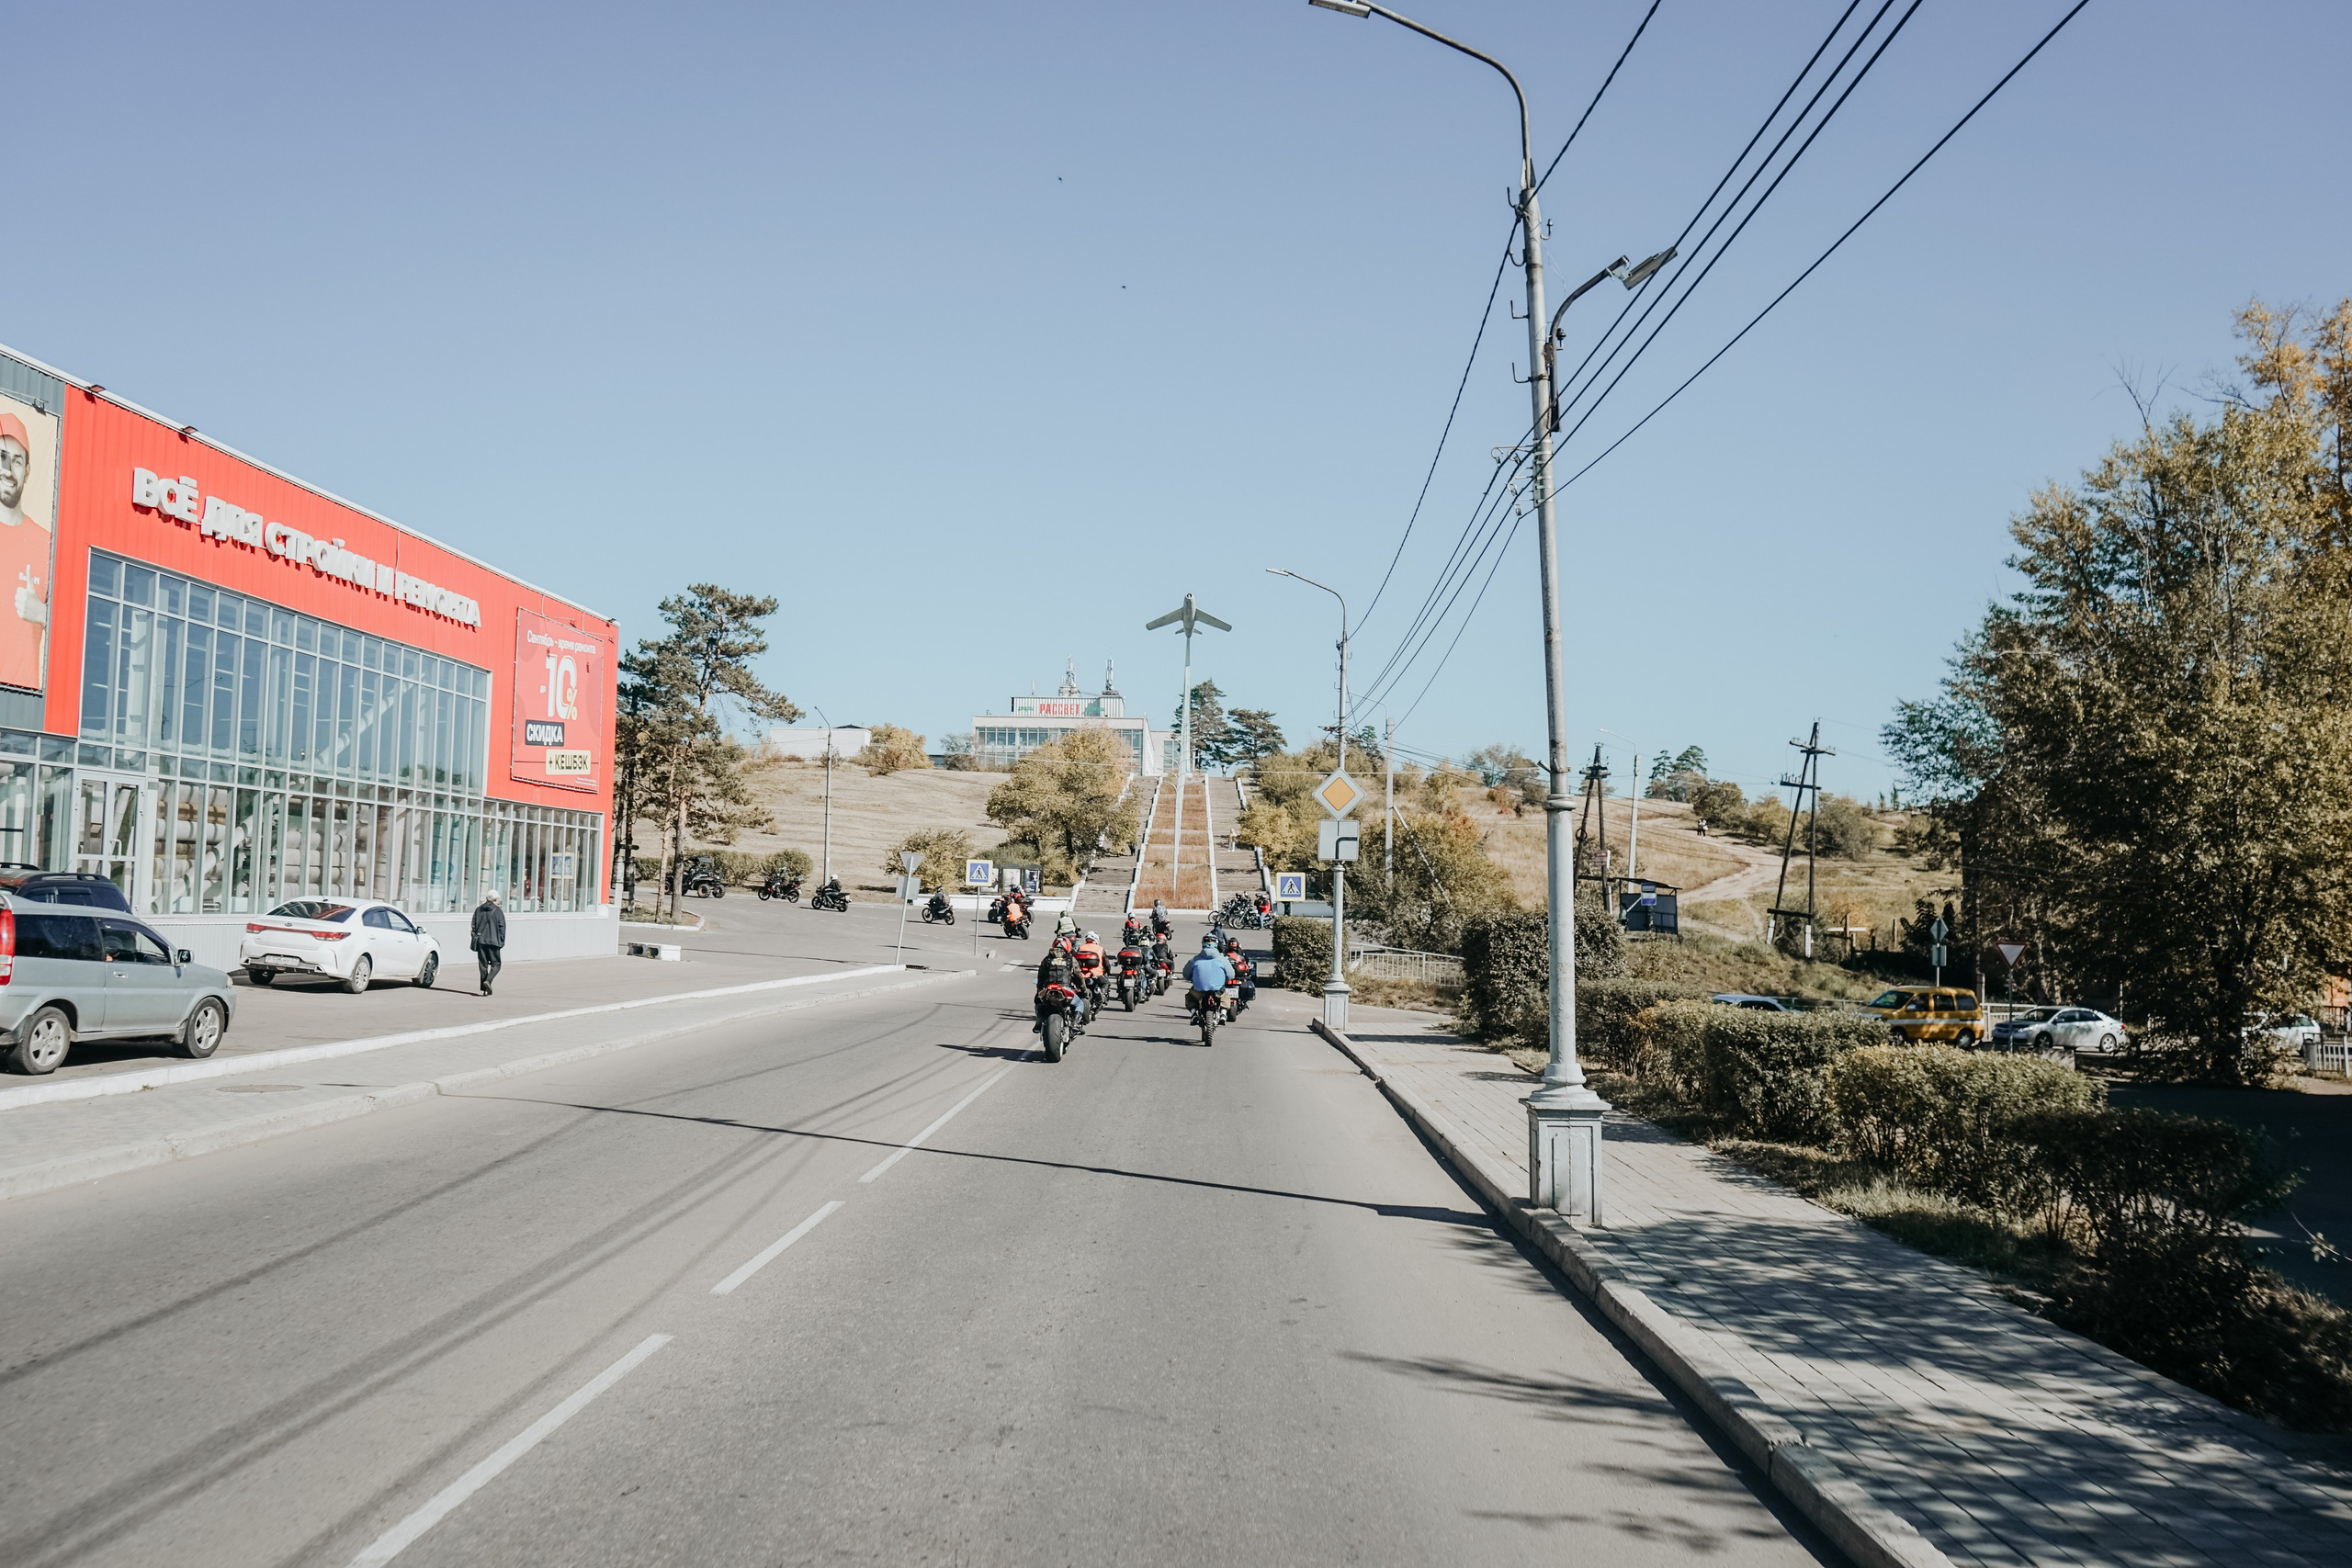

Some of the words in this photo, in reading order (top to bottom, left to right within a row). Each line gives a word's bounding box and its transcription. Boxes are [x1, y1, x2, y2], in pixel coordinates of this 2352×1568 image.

[132, 467, 199, 525] ВСЁ
[201, 495, 263, 547] ДЛЯ
[265, 522, 376, 589] СТРОЙКИ
[376, 563, 394, 596] И
[395, 571, 482, 627] РЕМОНТА
[527, 629, 554, 649] Сентябрь
[558, 639, 574, 651] время
[574, 642, 596, 654] ремонта
[1039, 703, 1080, 716] РАССВЕТ
[526, 723, 563, 746] СКИДКА
[555, 754, 588, 771] КЕШБЭК
